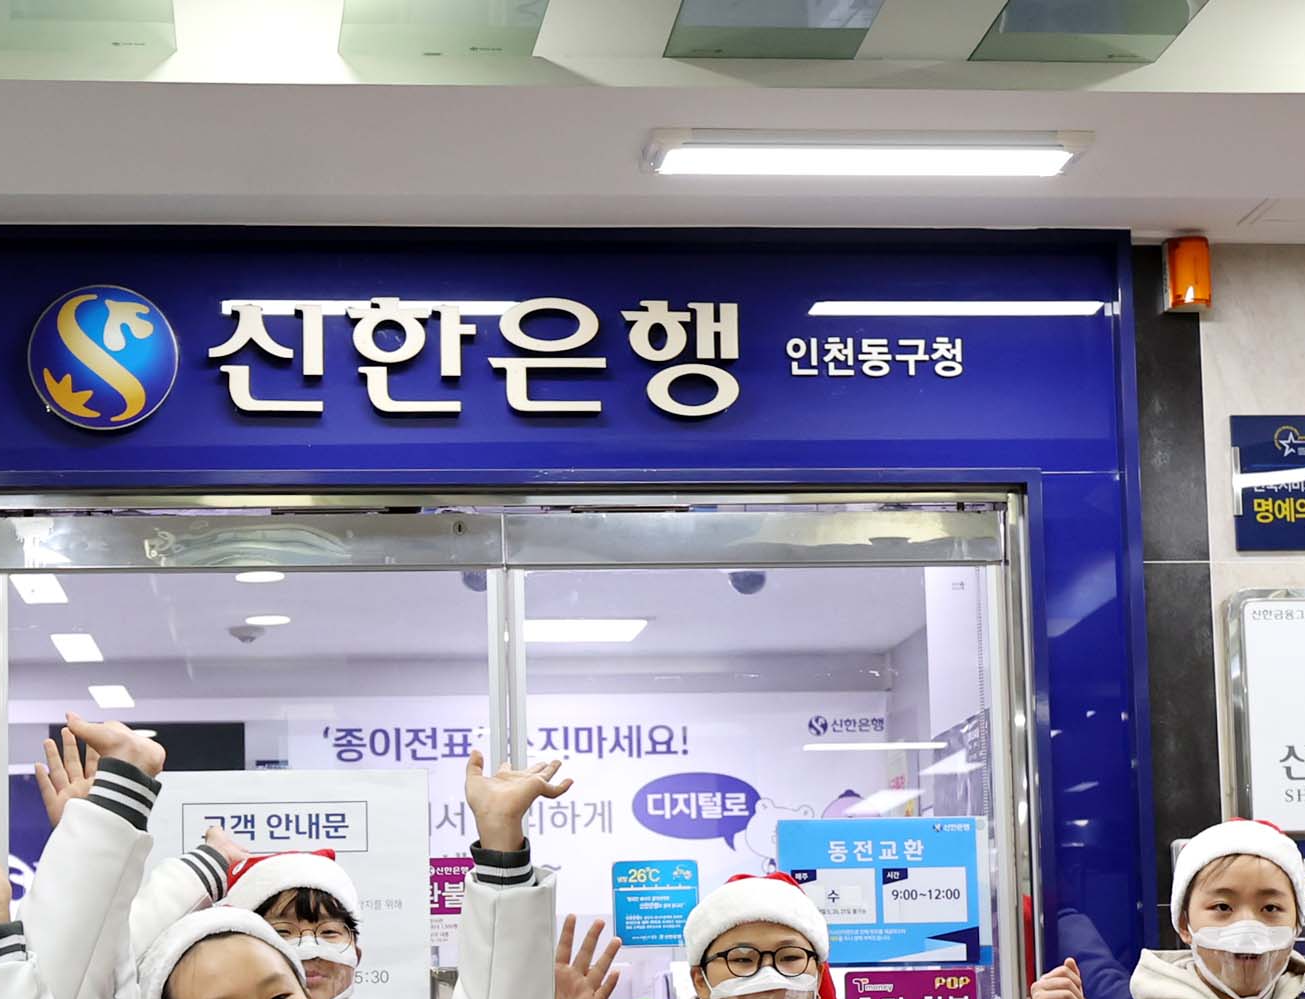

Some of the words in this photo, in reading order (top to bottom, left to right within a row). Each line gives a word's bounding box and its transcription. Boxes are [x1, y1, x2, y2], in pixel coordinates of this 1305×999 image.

[208, 296, 739, 419] 신한은행
[784, 335, 965, 379] 인천동구청
[831, 716, 885, 733] 신한은행
[526, 724, 688, 760] 지마세요!
[646, 791, 750, 820] 디지털로
[266, 812, 350, 840] 안내문
[827, 839, 925, 864] 동전교환
[886, 871, 900, 880] 시간
[827, 889, 841, 904] 수
[891, 888, 961, 901] 9:00~12:00
[934, 976, 971, 990] POP
